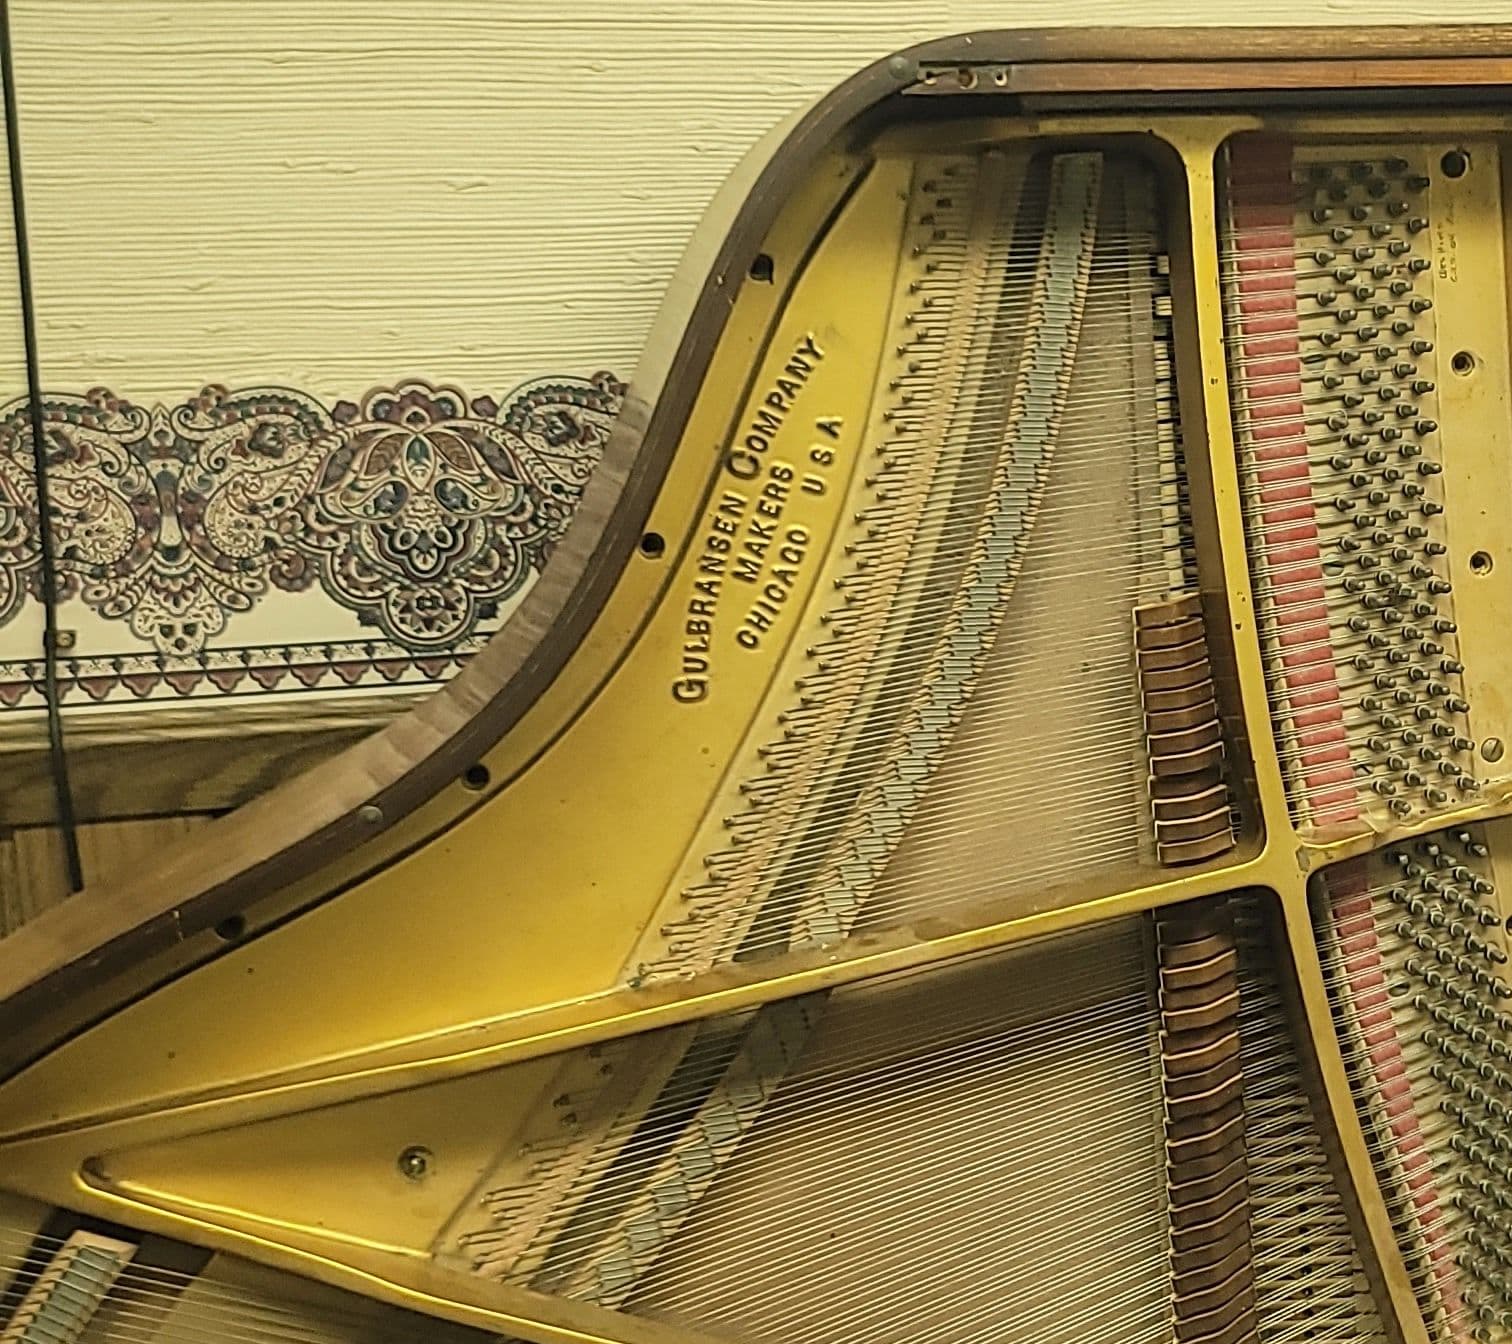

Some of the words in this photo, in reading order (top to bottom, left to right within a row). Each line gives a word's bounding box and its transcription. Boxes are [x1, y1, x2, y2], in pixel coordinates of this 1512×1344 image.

[672, 492, 748, 704] GULBRANSEN
[725, 331, 826, 482] COMPANY
[732, 463, 795, 584] MAKERS
[736, 523, 811, 650] CHICAGO
